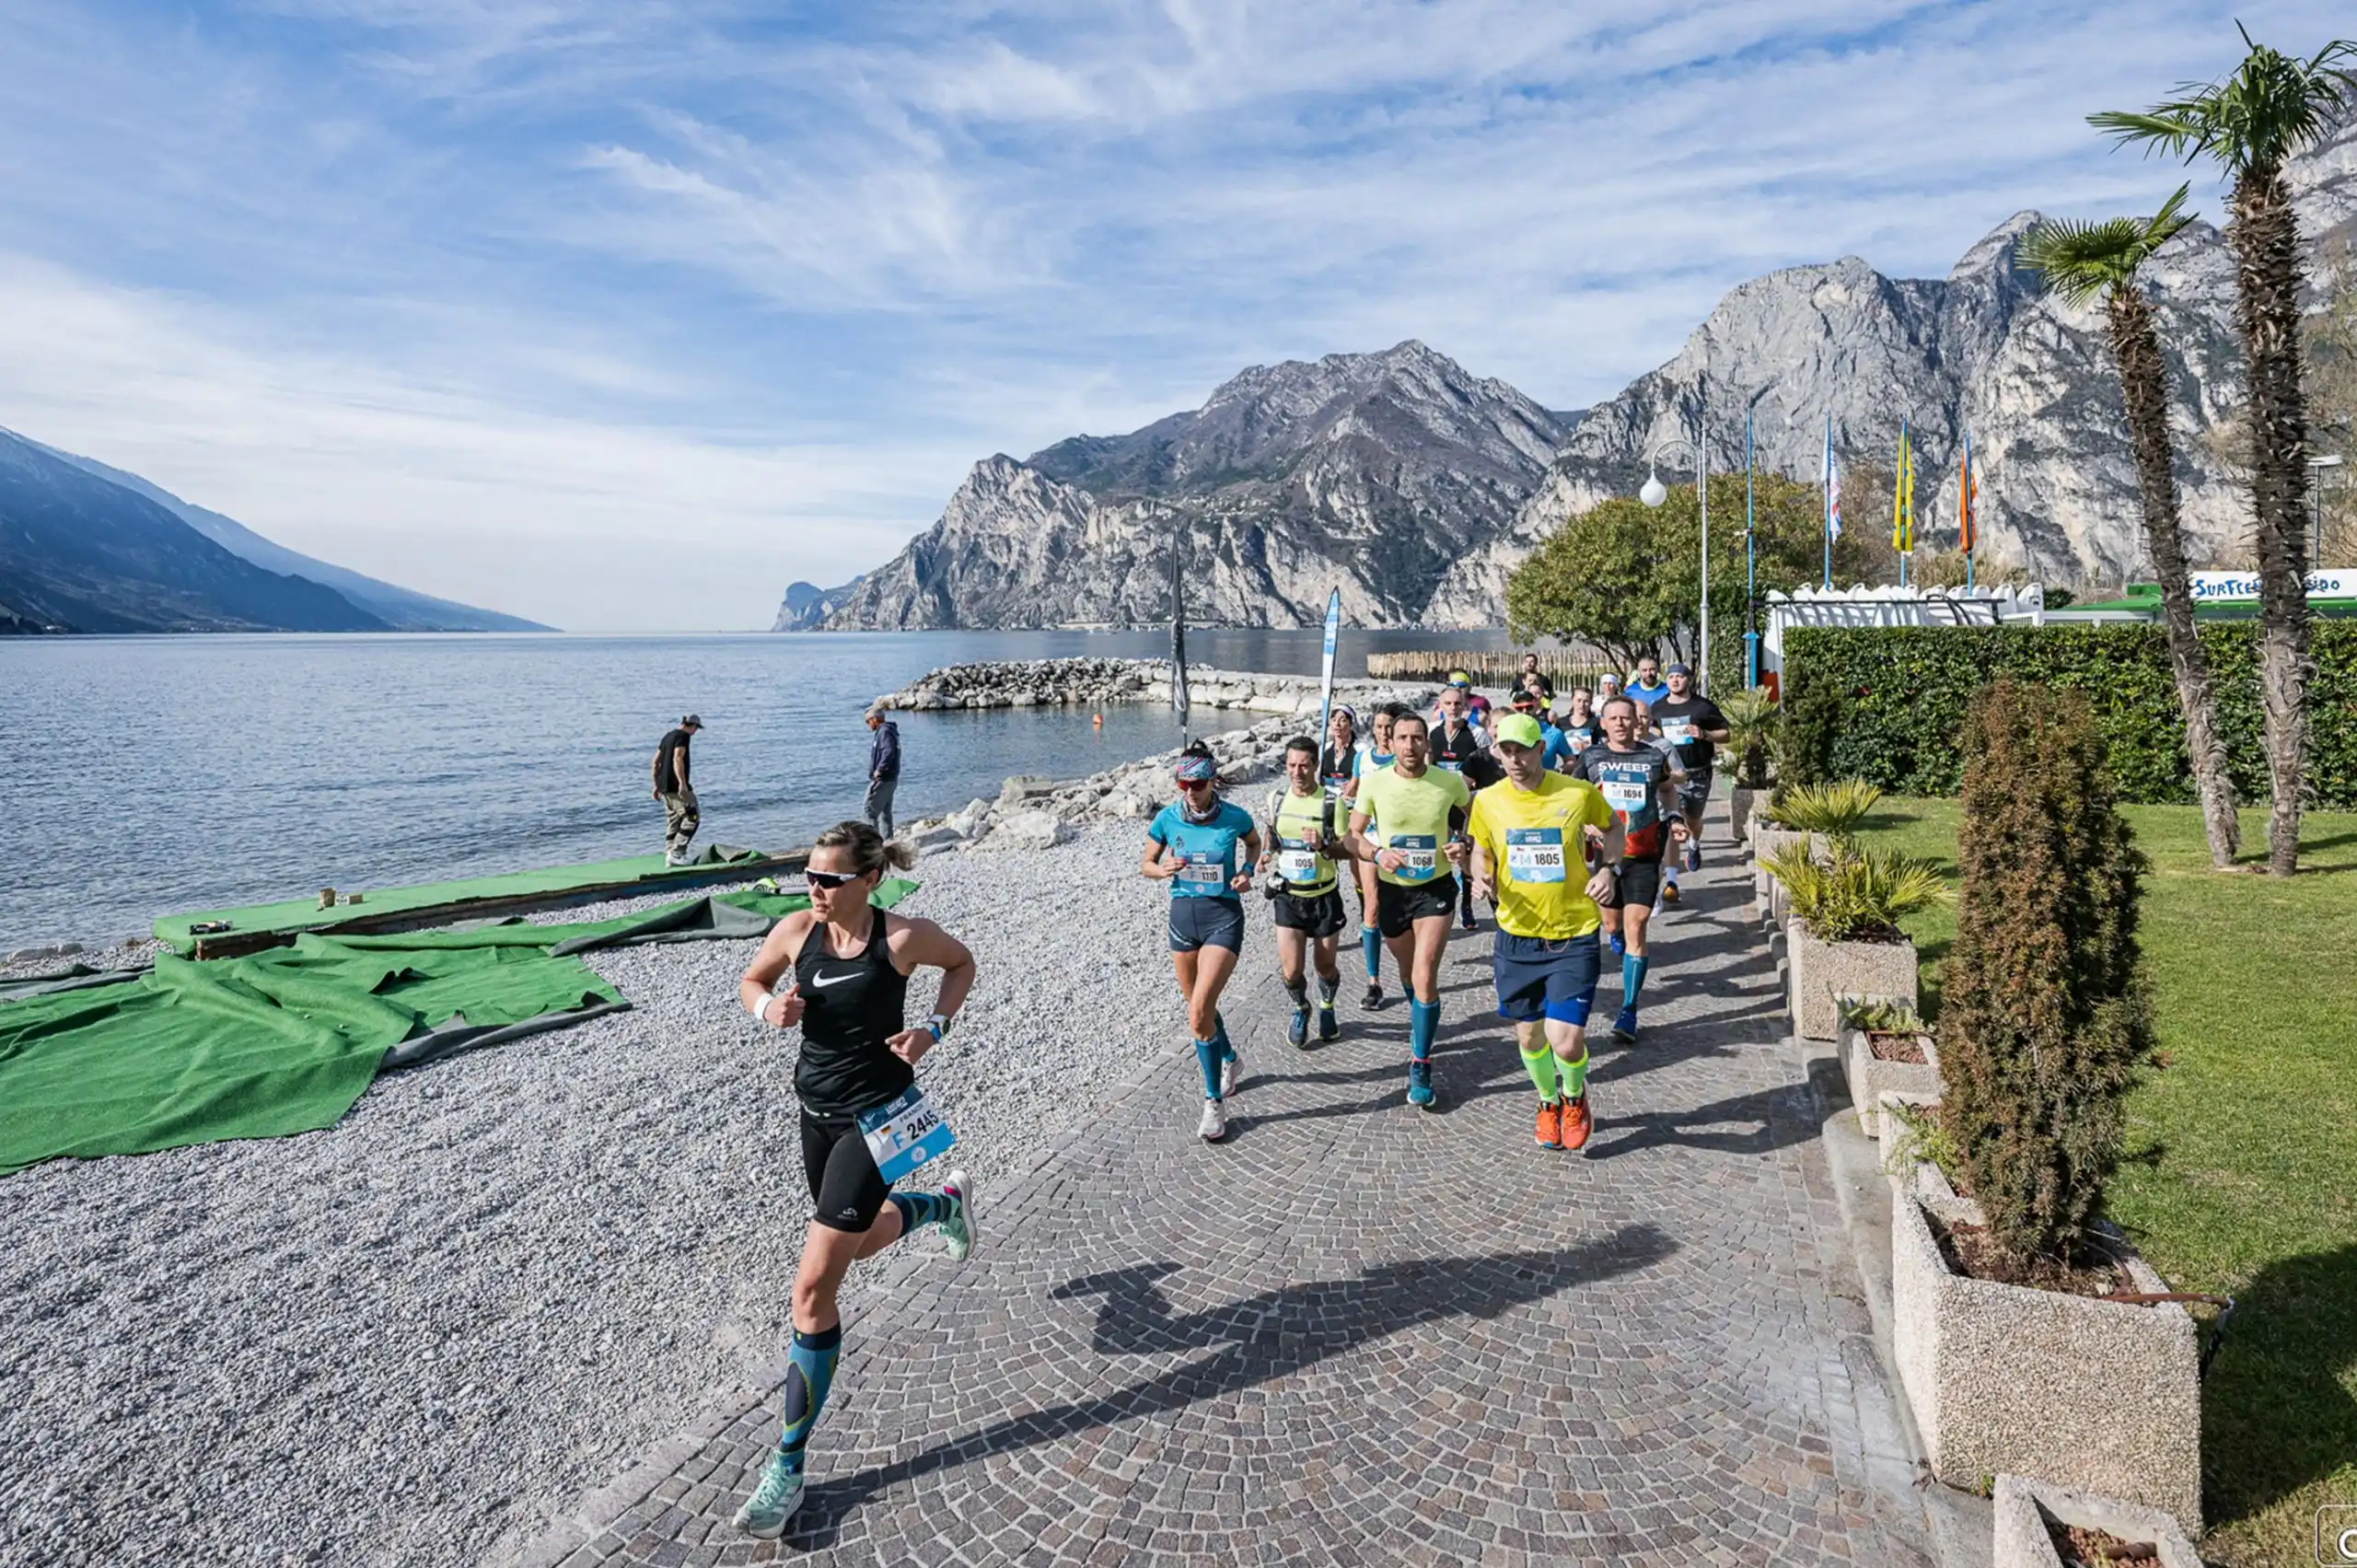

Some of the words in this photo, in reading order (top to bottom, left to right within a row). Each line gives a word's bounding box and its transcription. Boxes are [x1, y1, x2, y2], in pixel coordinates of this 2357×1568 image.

[1597, 761, 1652, 772] SWEEP
[1623, 789, 1643, 798] 1694
[1295, 858, 1313, 867] 1005
[1412, 856, 1433, 866] 1068
[1535, 854, 1560, 865] 1805
[1202, 871, 1218, 881] 1110
[892, 1131, 905, 1149] F
[907, 1109, 939, 1141] 2445
